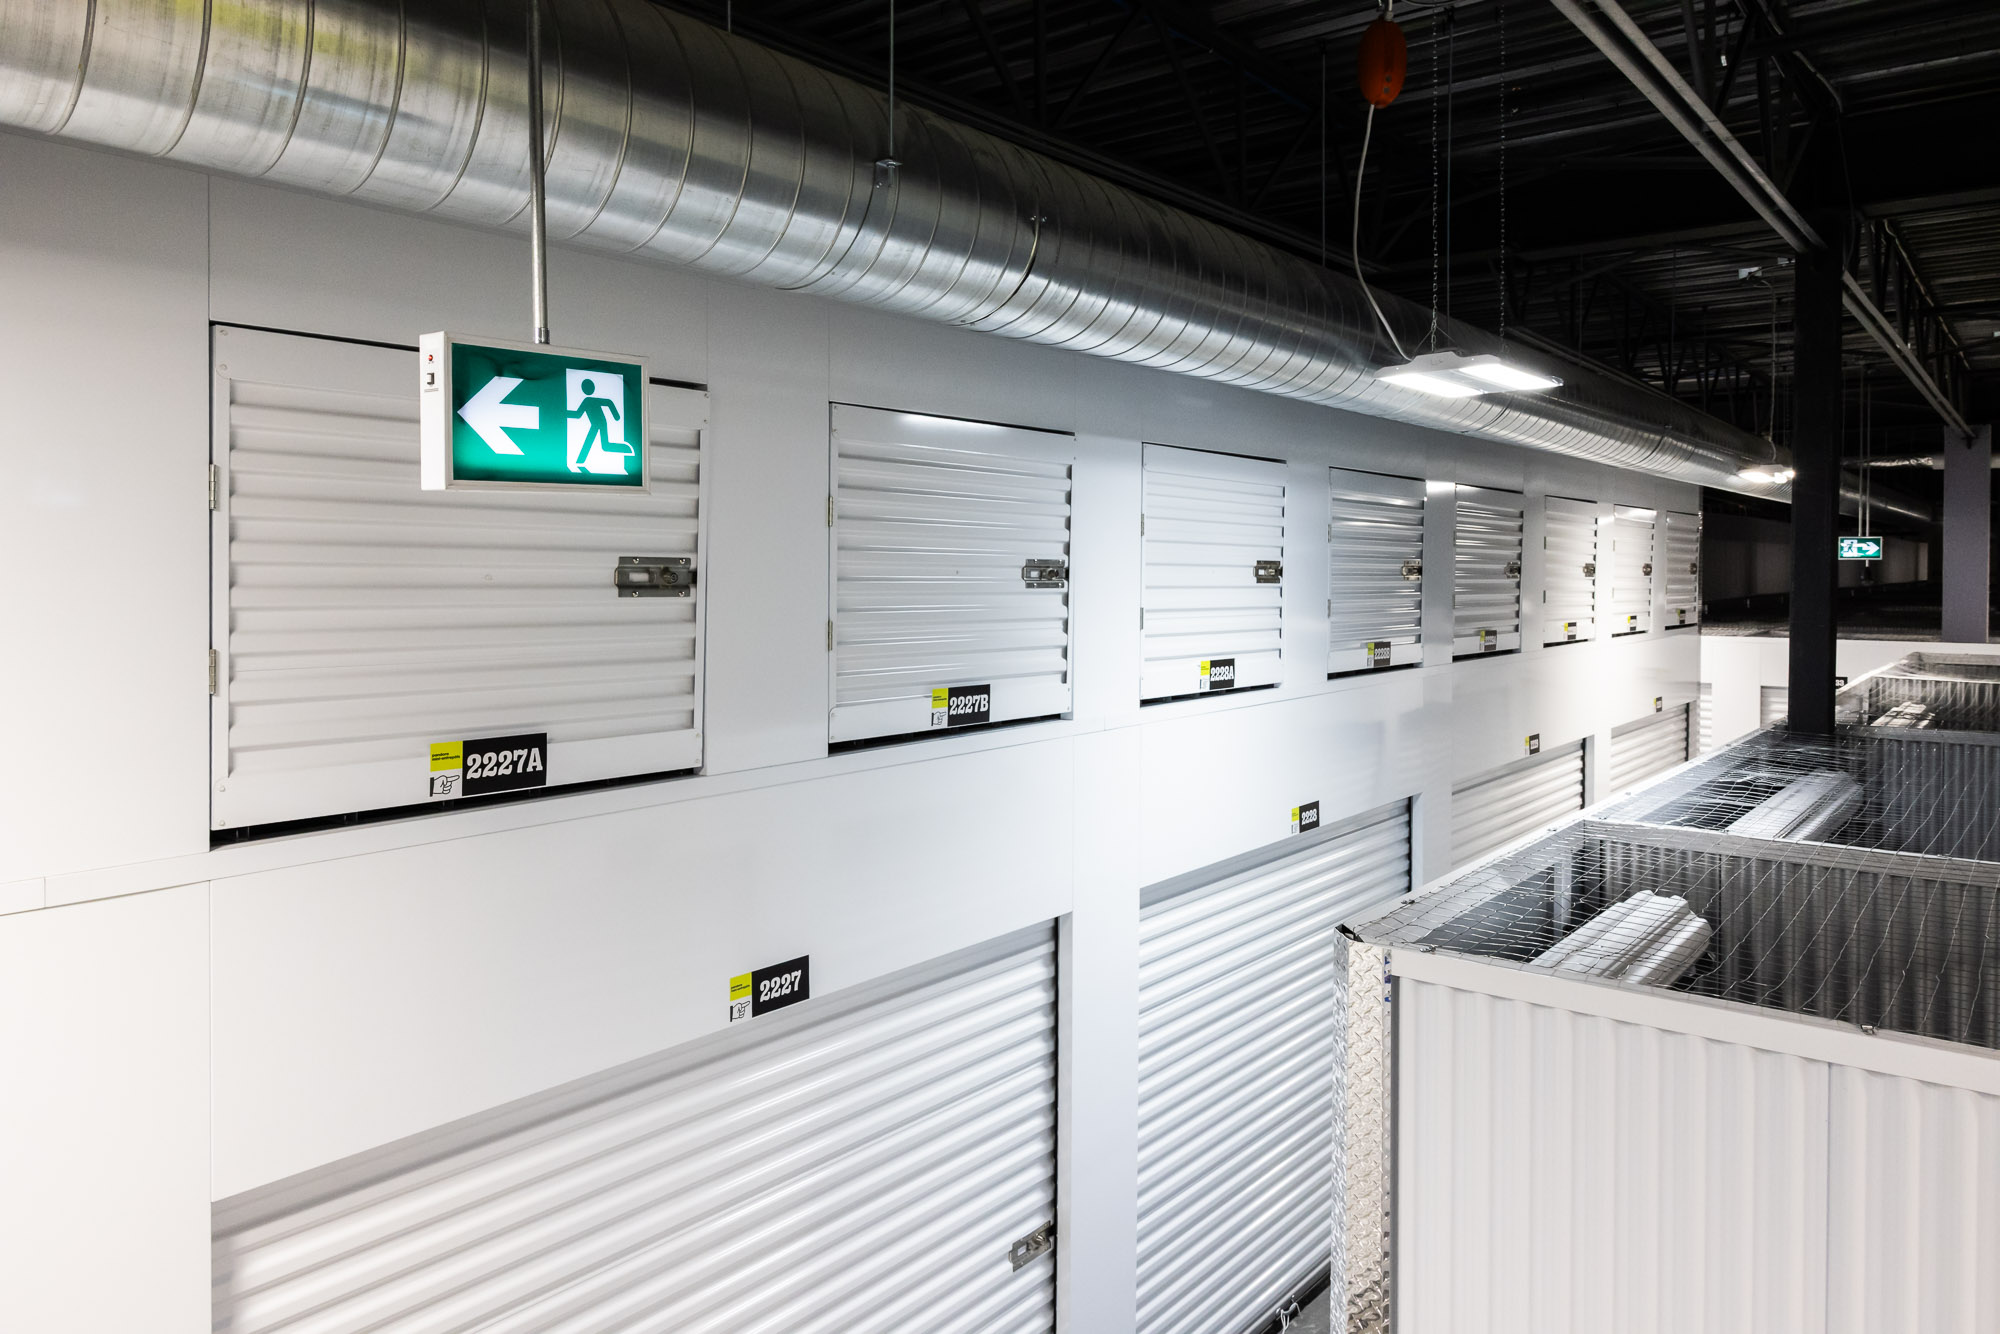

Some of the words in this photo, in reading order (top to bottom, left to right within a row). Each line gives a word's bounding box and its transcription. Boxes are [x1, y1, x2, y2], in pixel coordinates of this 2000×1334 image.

[1211, 665, 1234, 682] 2228A
[949, 694, 989, 715] 2227B
[466, 747, 543, 780] 2227A
[1301, 808, 1318, 825] 2228
[759, 969, 802, 1003] 2227
